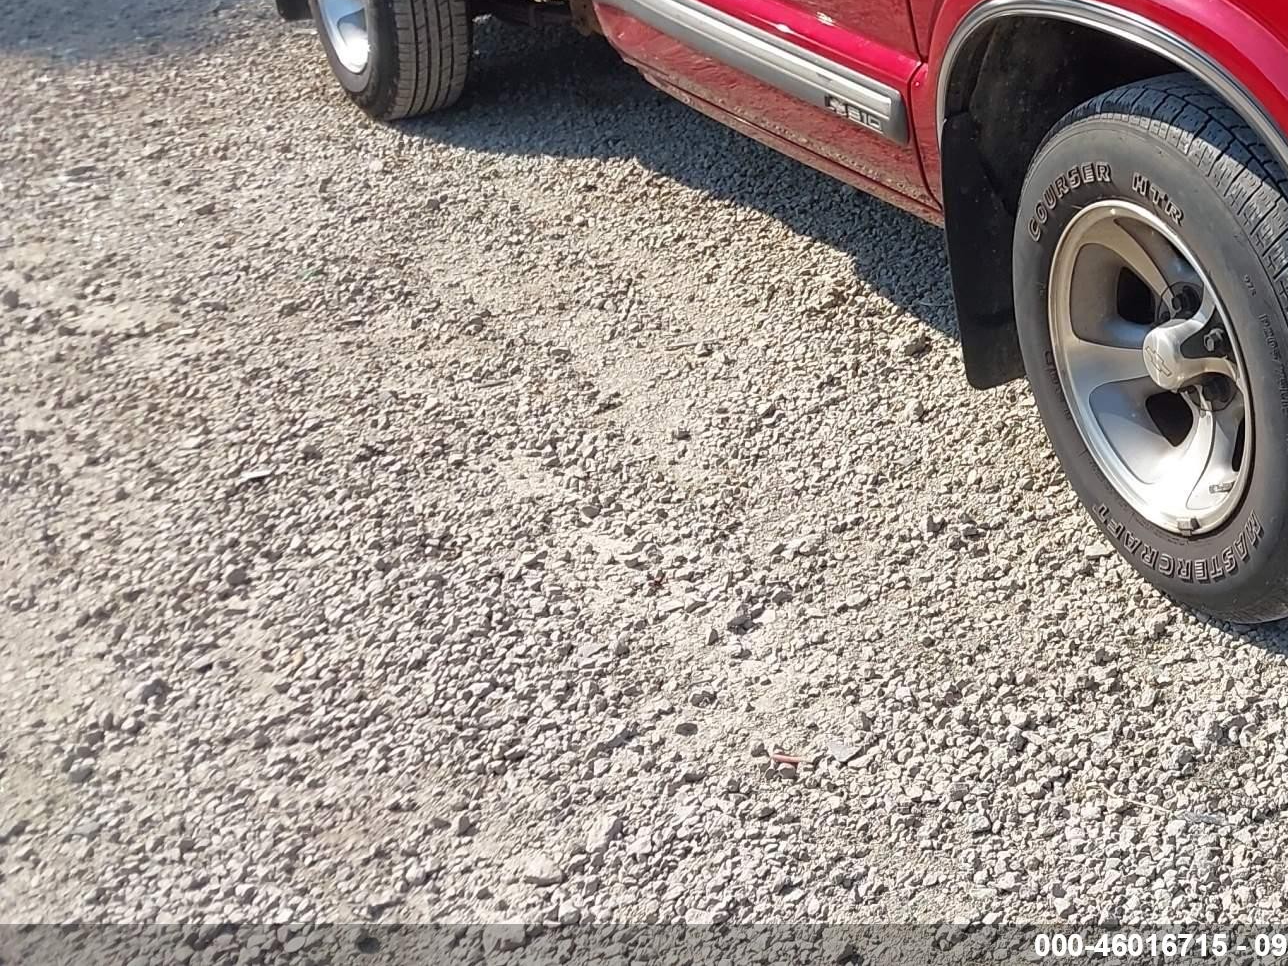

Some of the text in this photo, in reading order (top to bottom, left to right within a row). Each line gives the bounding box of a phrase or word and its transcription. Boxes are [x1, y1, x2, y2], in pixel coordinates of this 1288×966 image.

[1027, 161, 1184, 242] COURSER HTR
[1093, 503, 1264, 583] MASTERCRAFT
